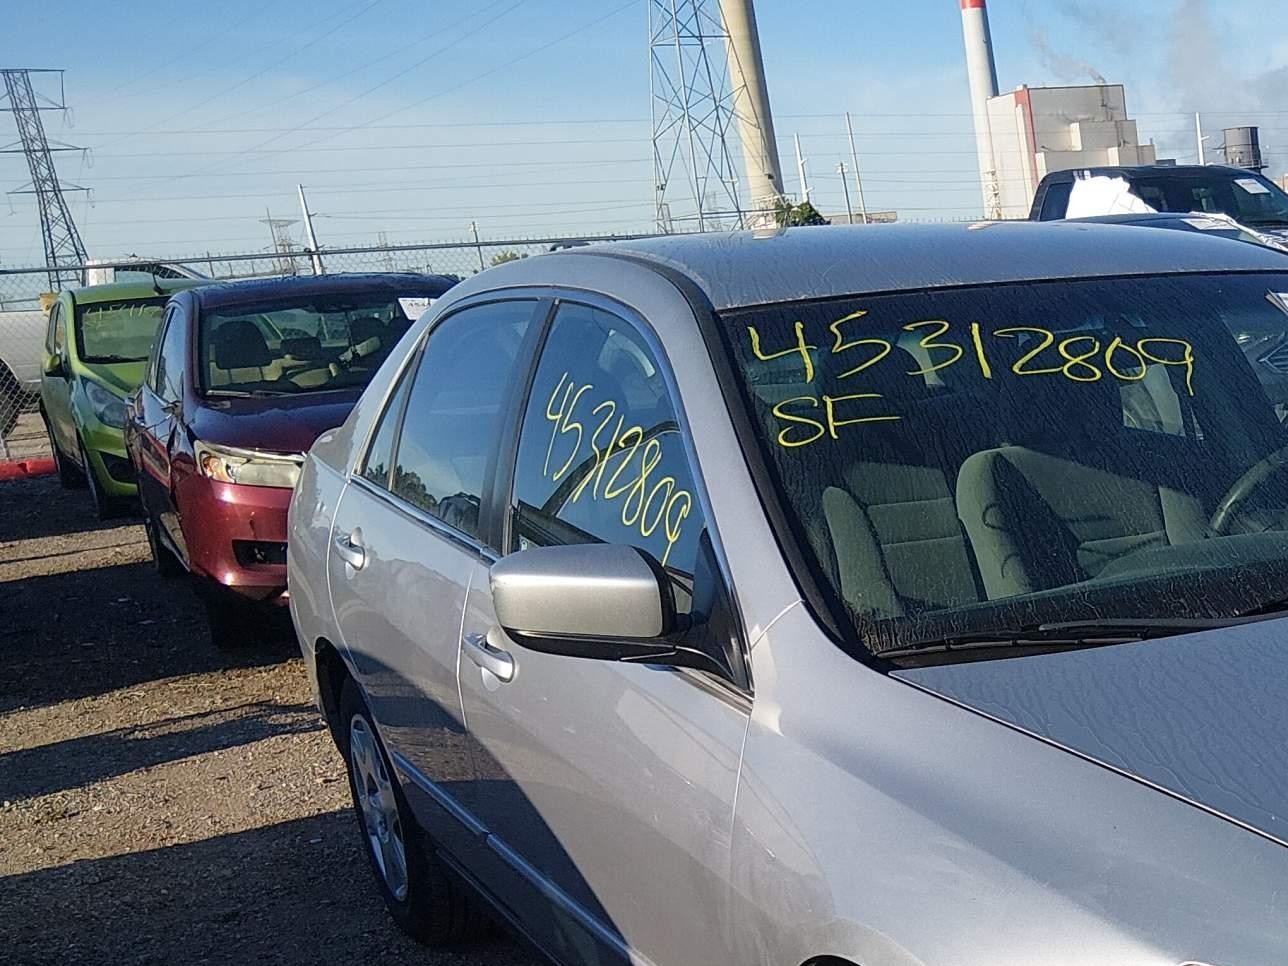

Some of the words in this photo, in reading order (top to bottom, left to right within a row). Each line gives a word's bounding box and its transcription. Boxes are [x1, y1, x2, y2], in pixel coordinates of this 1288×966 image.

[747, 310, 1195, 396] 45312809
[772, 393, 902, 448] SF
[543, 371, 691, 566] 45312809
